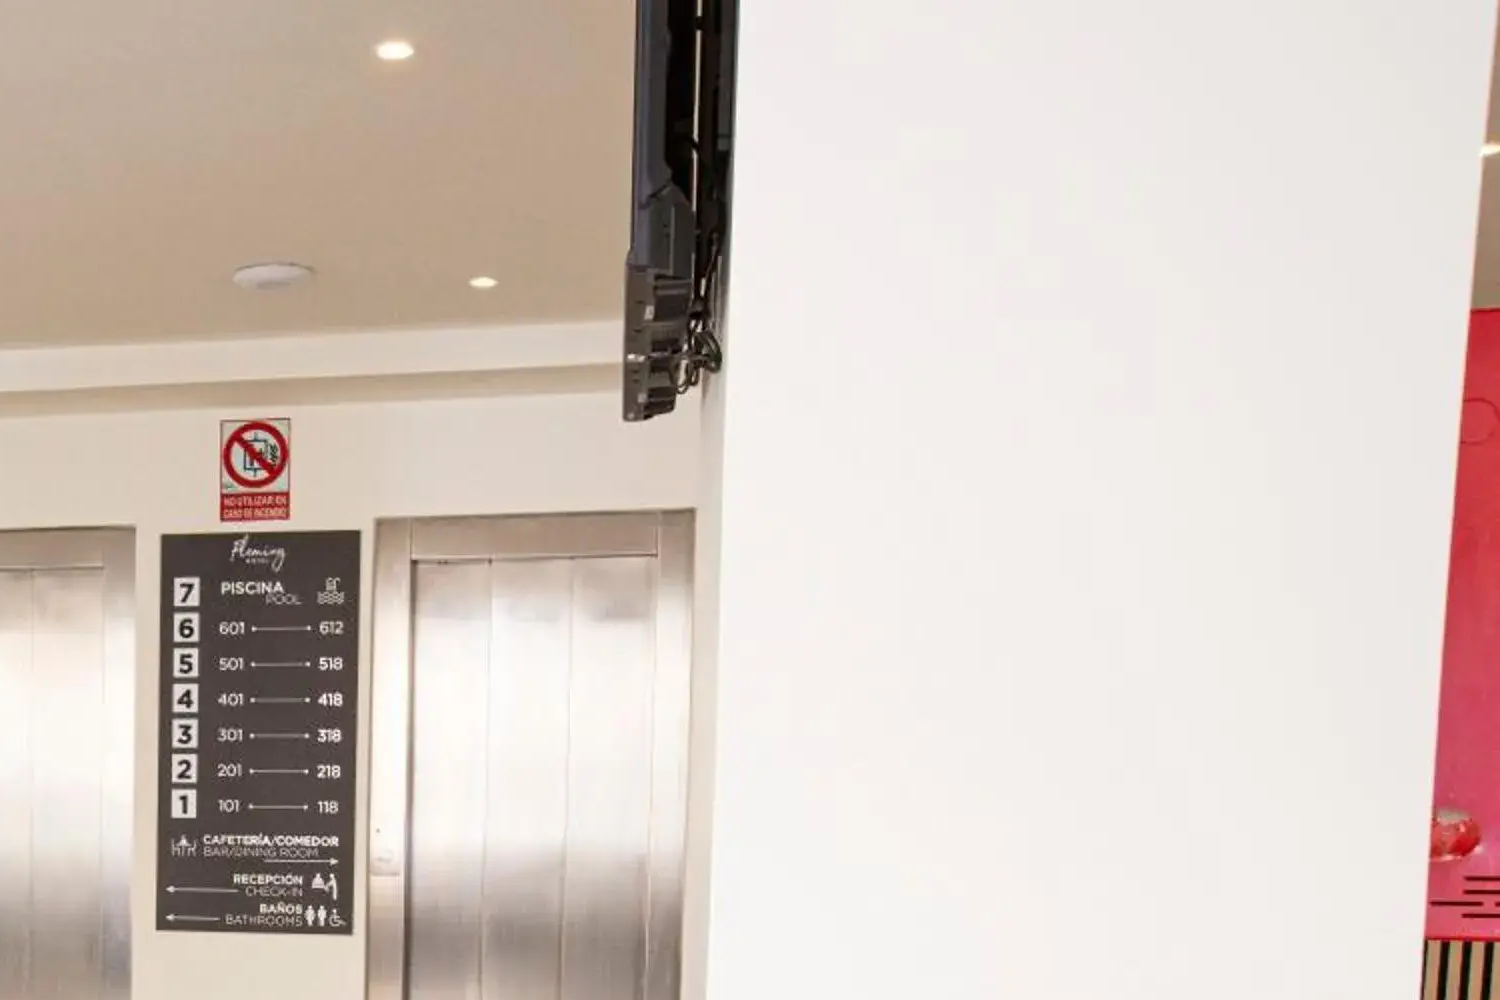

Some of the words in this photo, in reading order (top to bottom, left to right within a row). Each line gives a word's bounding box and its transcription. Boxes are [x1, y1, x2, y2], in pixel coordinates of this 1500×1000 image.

[230, 533, 286, 572] Fleming
[179, 582, 195, 603] 7
[220, 581, 285, 595] PISCINA
[265, 593, 302, 605] POOL
[178, 618, 195, 639] 6
[218, 621, 245, 636] 601
[318, 620, 344, 636] 612
[179, 653, 194, 675] 5
[218, 656, 245, 671] 501
[318, 656, 344, 671] 518
[177, 689, 194, 709] 4
[217, 692, 244, 707] 401
[317, 692, 344, 707] 418
[177, 724, 193, 745] 3
[217, 728, 244, 743] 301
[317, 728, 342, 743] 318
[176, 759, 192, 780] 2
[217, 763, 243, 778] 201
[316, 764, 341, 779] 218
[179, 794, 188, 815] 1
[218, 799, 240, 813] 101
[317, 800, 339, 815] 118
[203, 833, 339, 847] CAFETERÍA/COMEDOR
[203, 847, 277, 858] BAR/DINING
[280, 847, 319, 858] ROOM
[233, 872, 303, 885] RECEPCIÓN
[245, 885, 303, 897] CHECK-IN
[259, 900, 303, 914] BAÑOS
[225, 913, 303, 927] BATHROOMS
